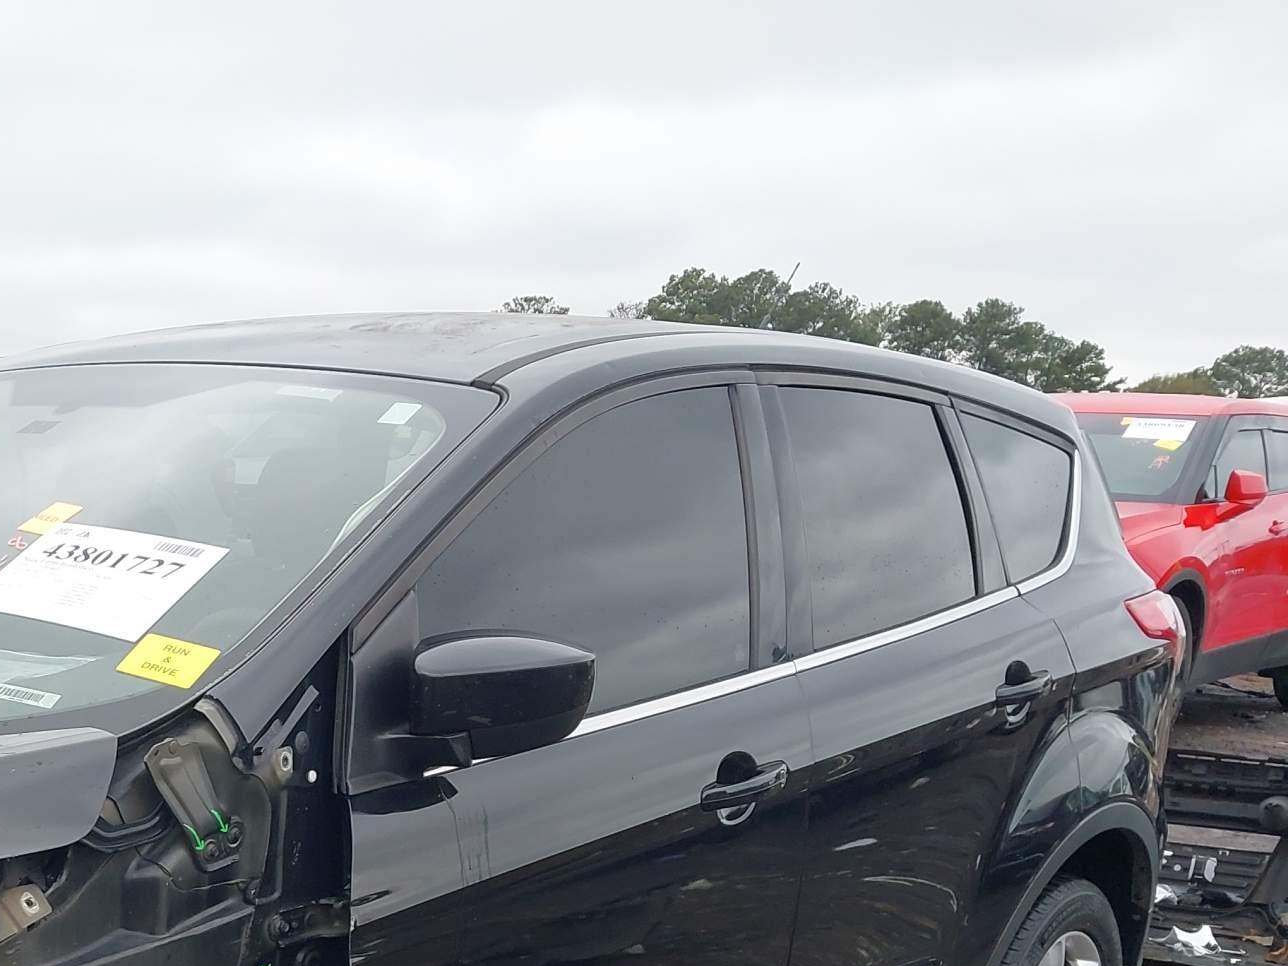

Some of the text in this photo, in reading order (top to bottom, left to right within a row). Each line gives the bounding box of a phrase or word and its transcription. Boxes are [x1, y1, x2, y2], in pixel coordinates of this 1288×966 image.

[41, 542, 188, 580] 43801727
[162, 644, 191, 657] RUN
[140, 660, 181, 677] DRIVE
